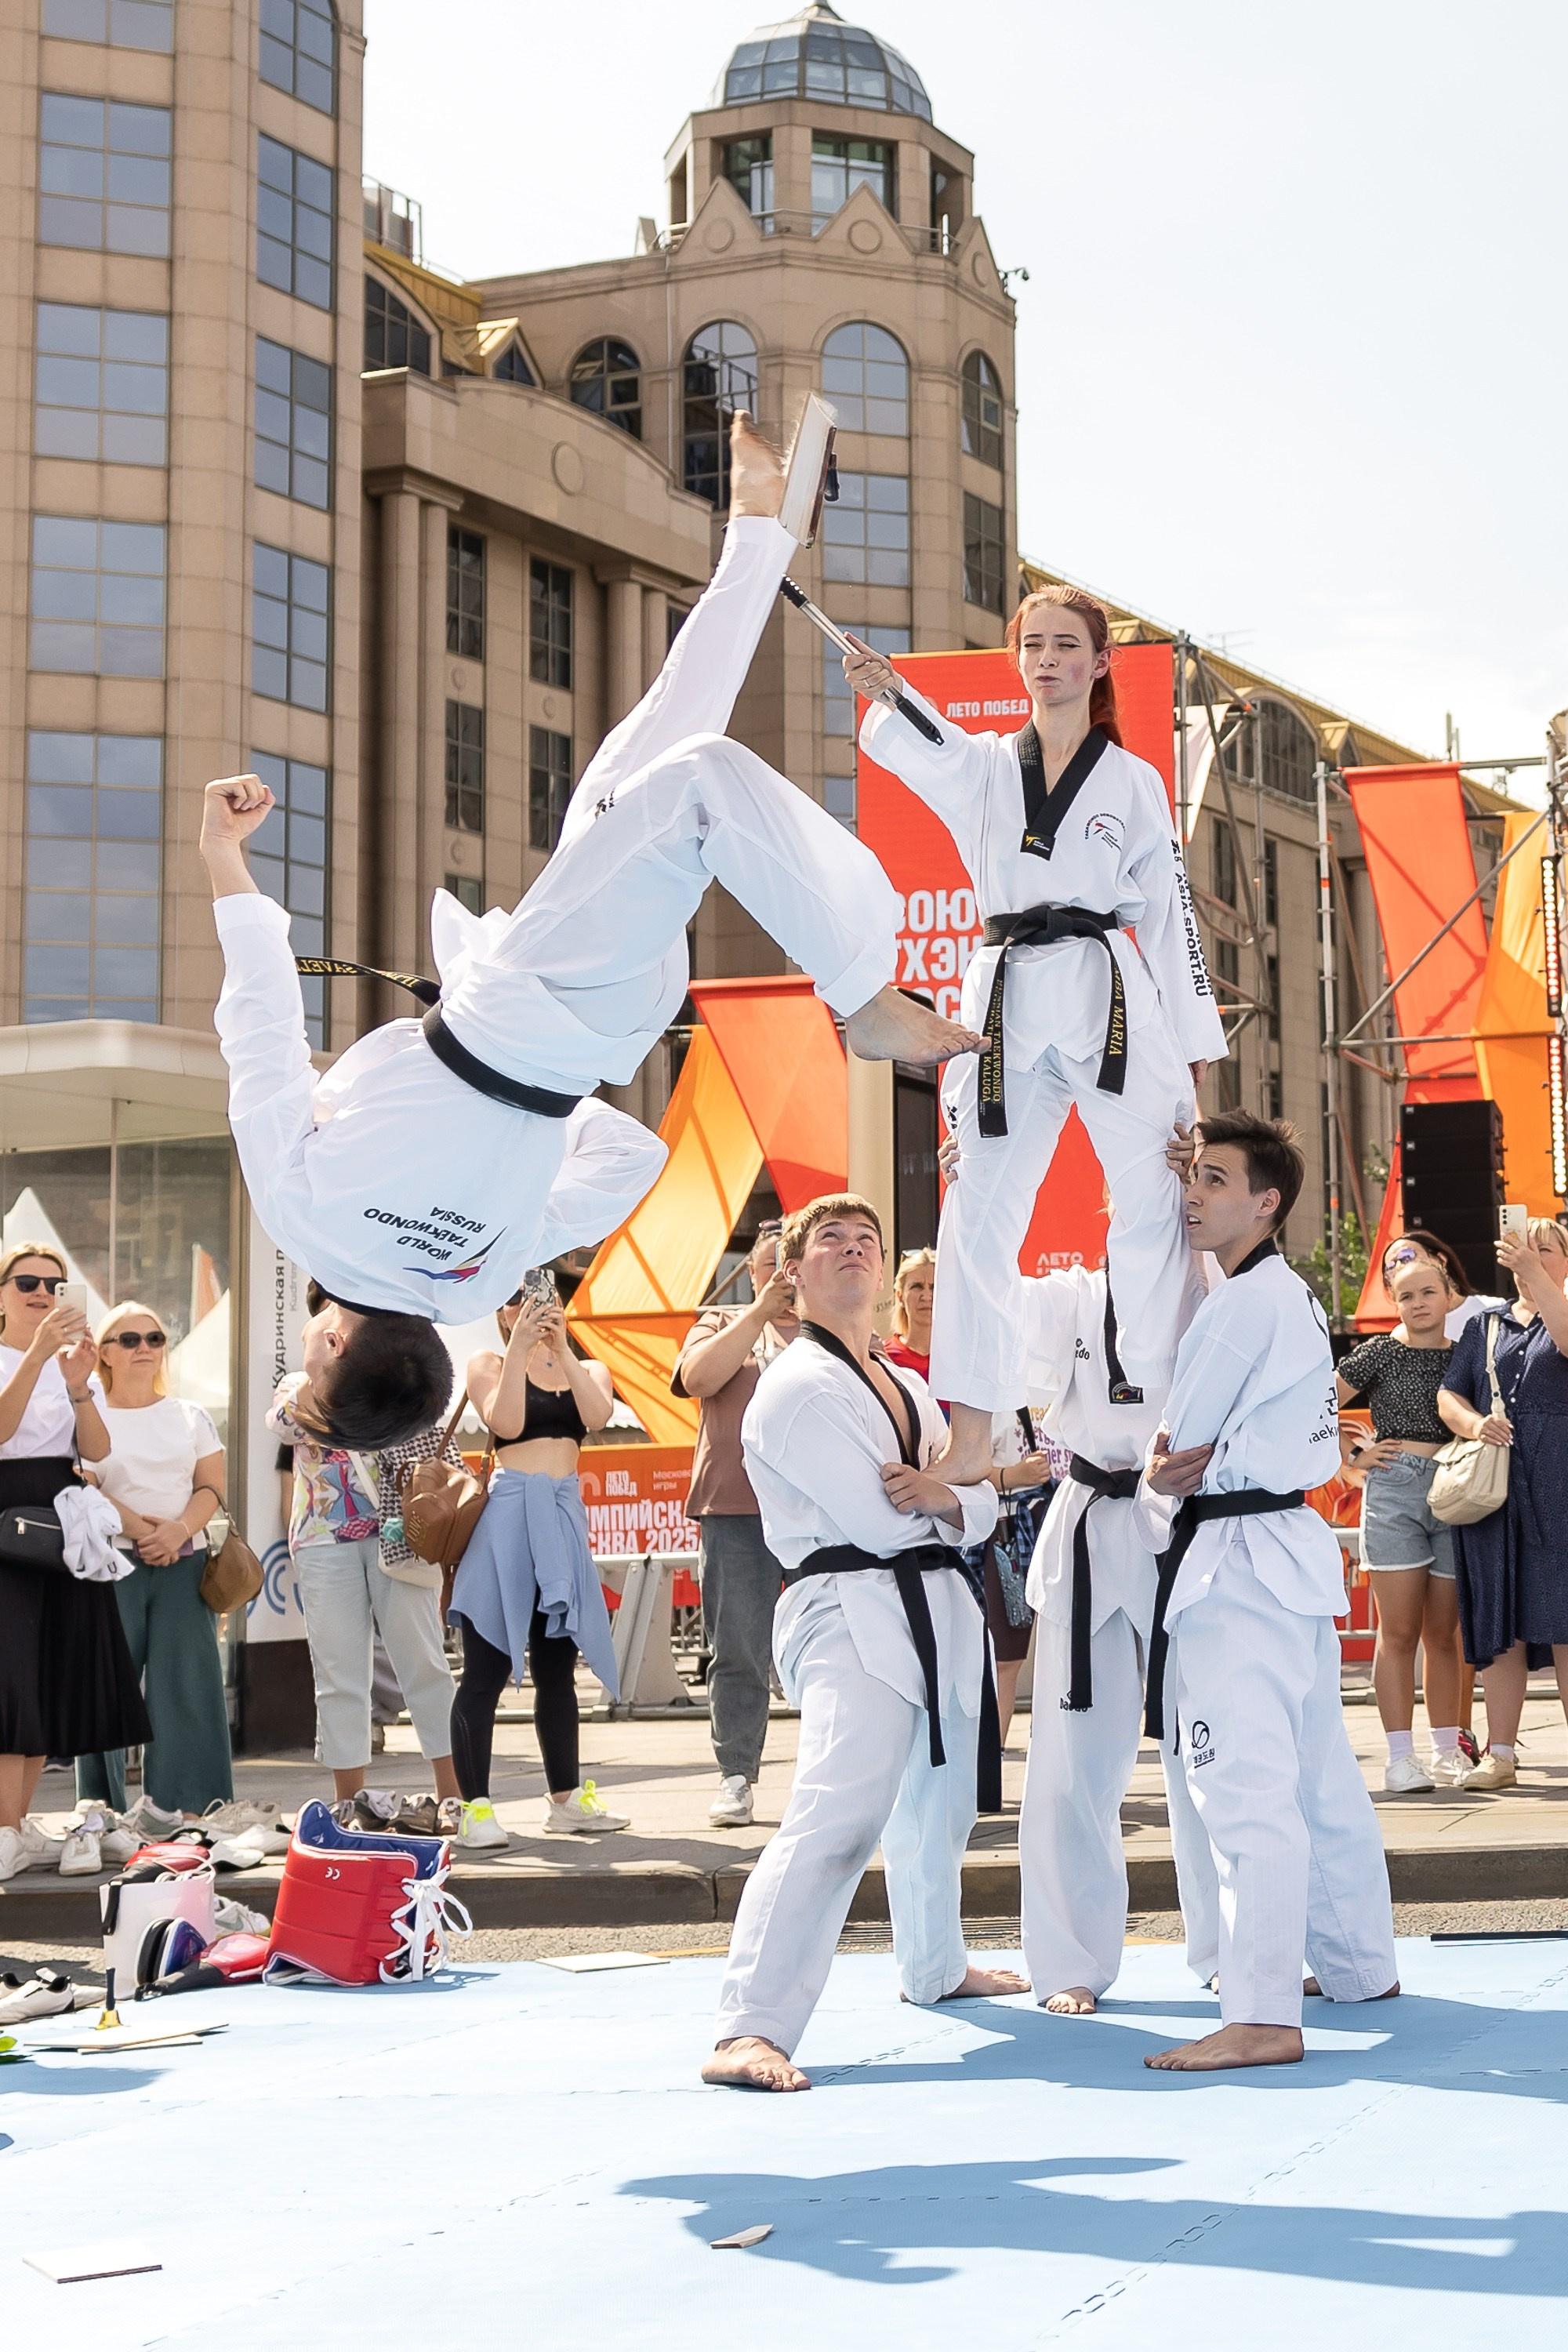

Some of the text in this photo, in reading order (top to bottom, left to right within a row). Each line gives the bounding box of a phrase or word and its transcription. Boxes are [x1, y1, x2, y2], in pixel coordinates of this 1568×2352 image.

[946, 699, 1029, 717] ЛЕТО ПОБЕД
[896, 887, 977, 933] ОЮ
[1175, 872, 1208, 996] ASIA-SPORT.RU
[1109, 1005, 1124, 1055] MARIA
[982, 1055, 993, 1102] KALUGA
[993, 1031, 1002, 1102] TAEKWONDO
[364, 1208, 469, 1248] TAEKWONDO
[430, 1207, 487, 1233] RUSSIA
[397, 1236, 452, 1261] WORLD
[586, 1499, 699, 1531] МПИЙСК
[588, 1527, 699, 1555] СКВА 2025
